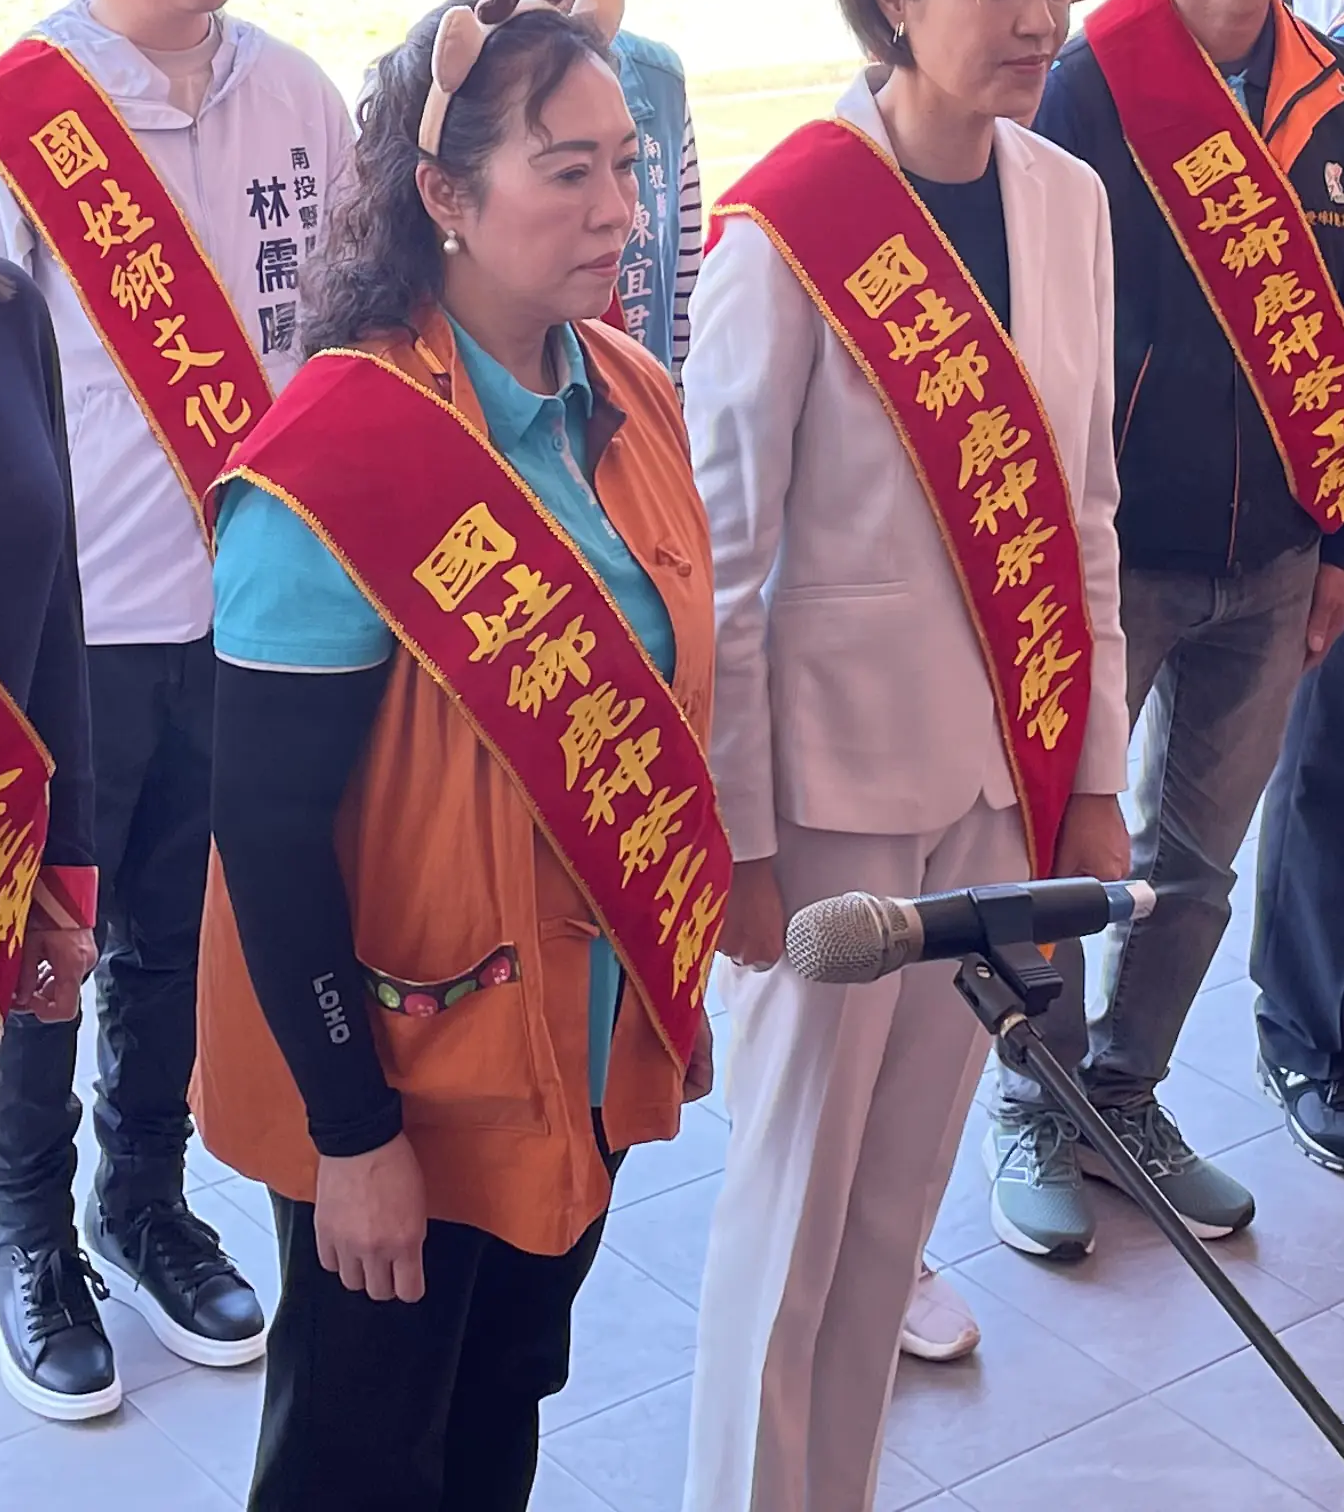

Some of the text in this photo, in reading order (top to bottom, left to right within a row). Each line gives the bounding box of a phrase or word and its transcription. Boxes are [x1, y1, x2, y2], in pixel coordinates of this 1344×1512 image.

[28, 109, 256, 464] 國姓鄉文化
[843, 233, 1084, 752] 國姓鄉鹿神祭正獻官
